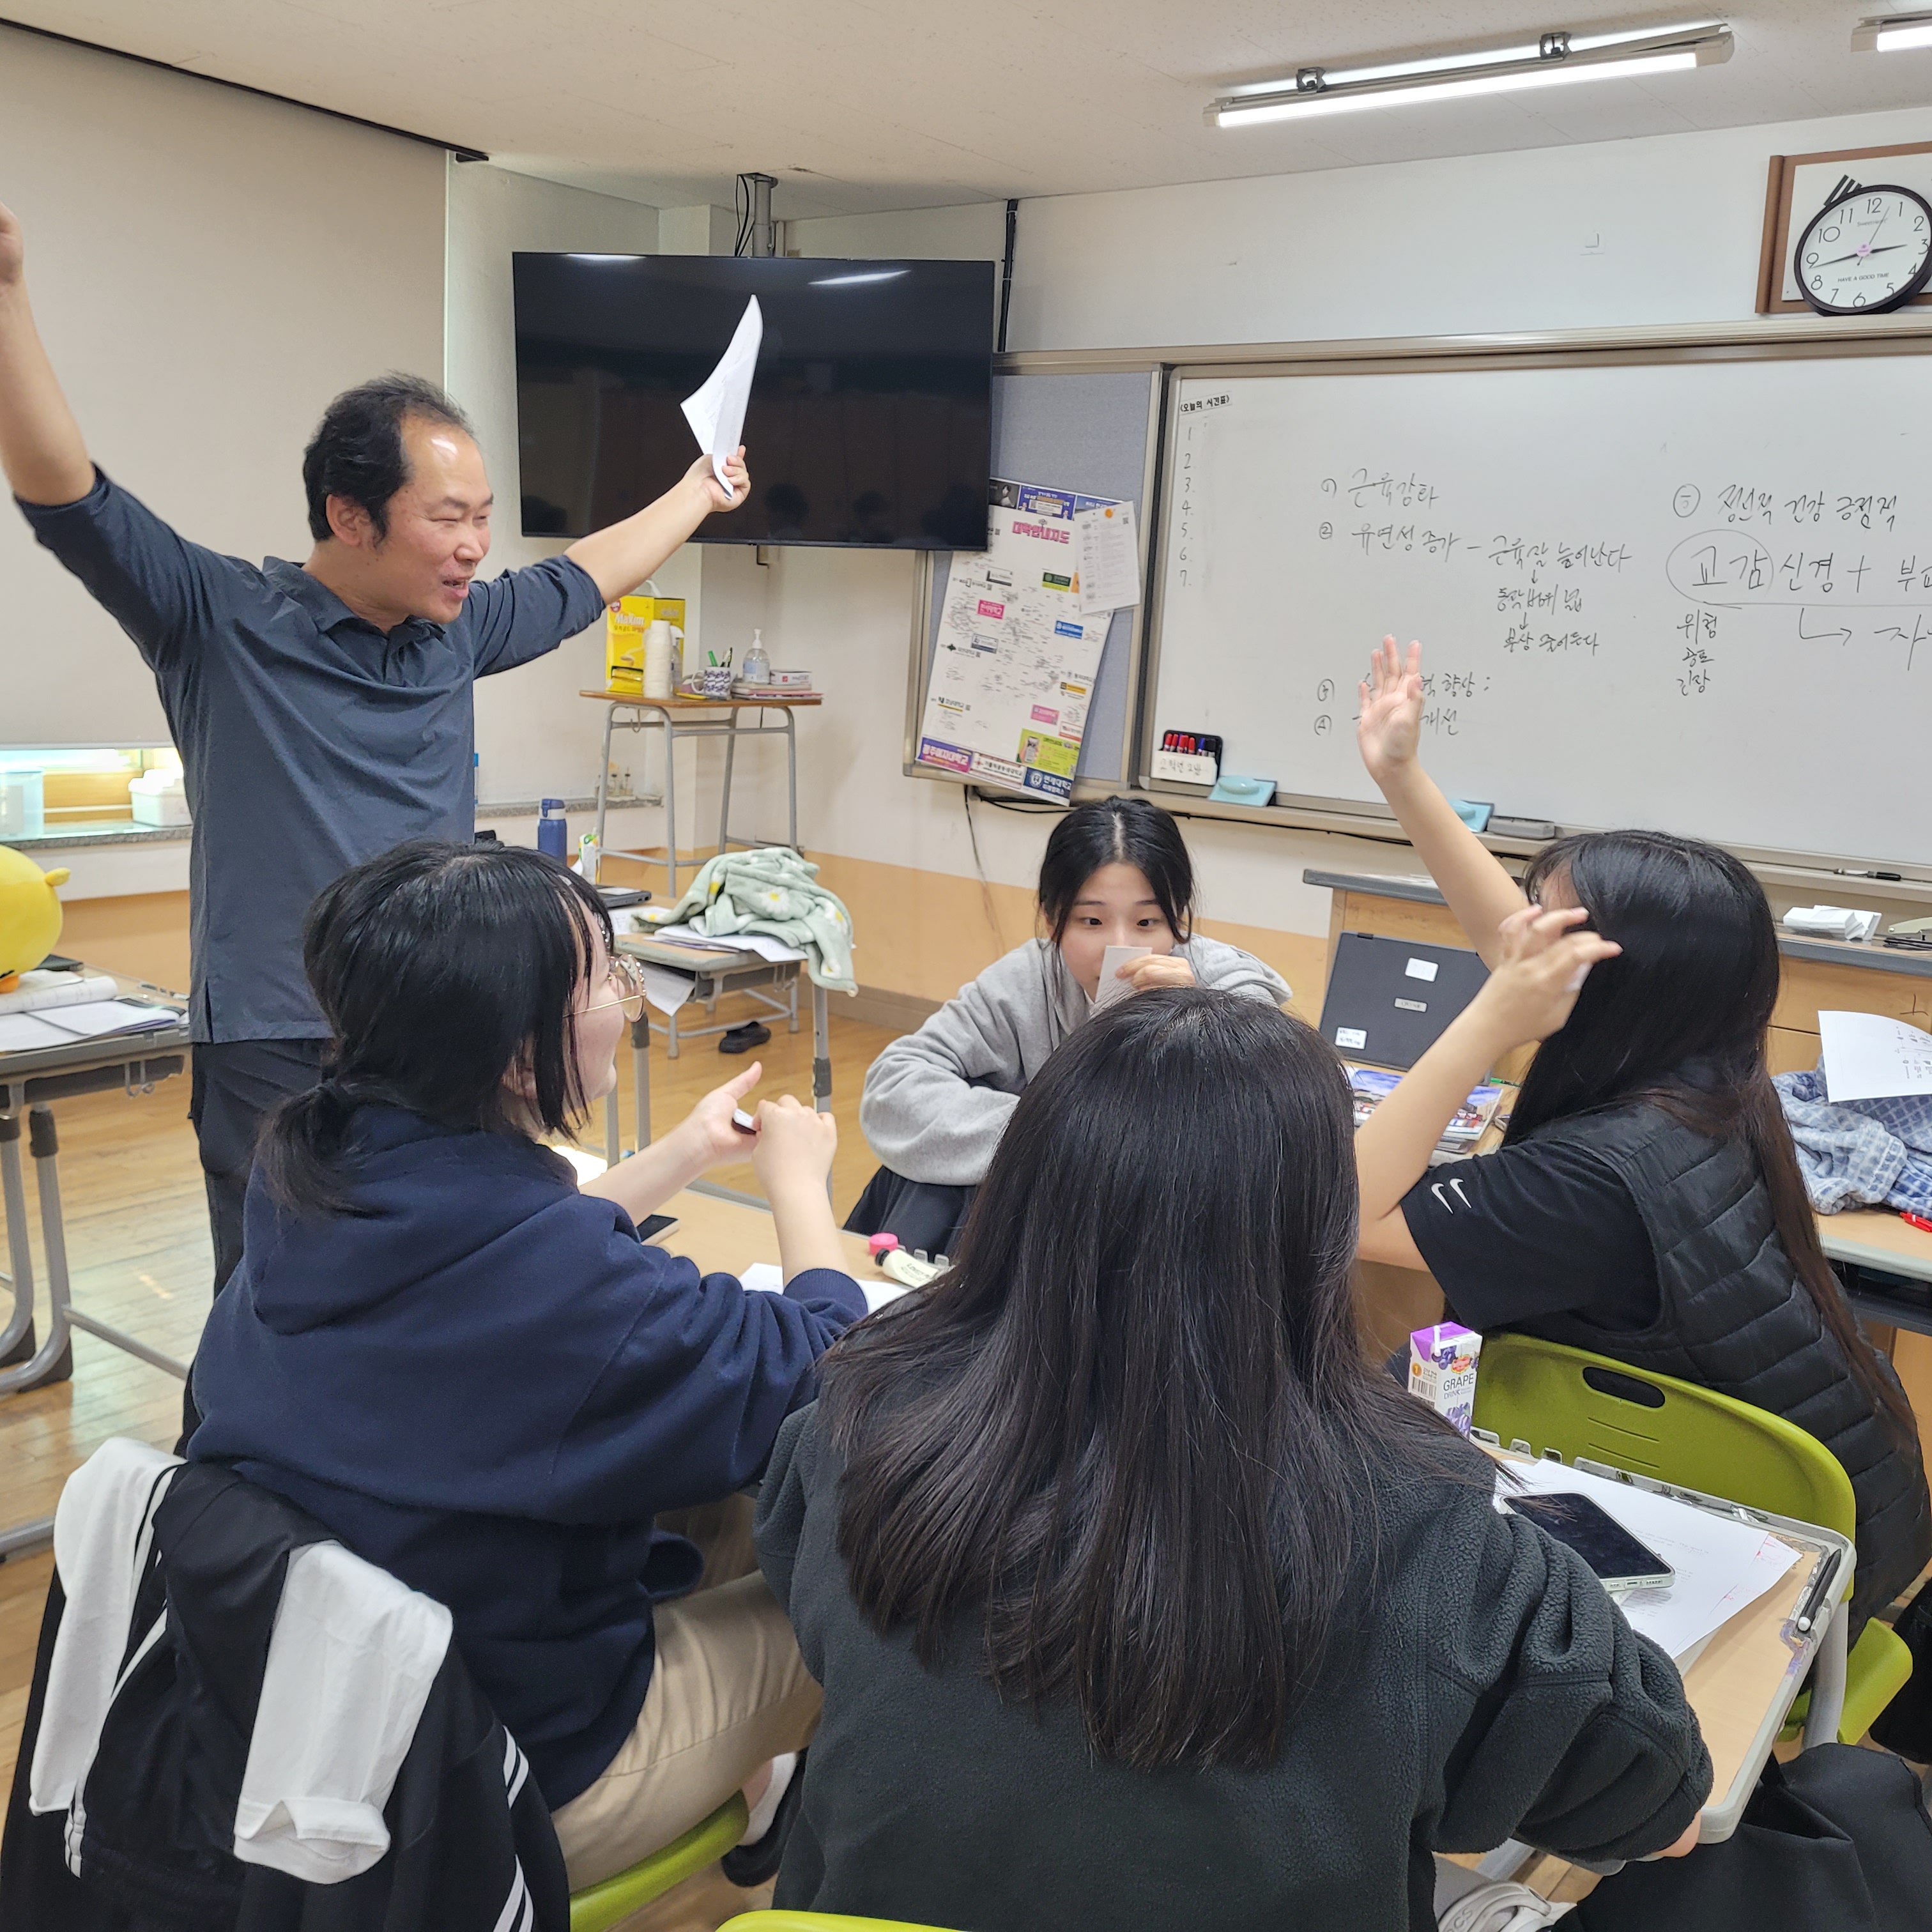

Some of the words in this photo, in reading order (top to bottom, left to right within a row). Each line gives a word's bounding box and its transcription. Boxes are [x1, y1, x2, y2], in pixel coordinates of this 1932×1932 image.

[1867, 197, 1882, 214] 12
[1899, 201, 1903, 217] 1
[1840, 208, 1853, 224] 11
[1913, 216, 1924, 232] 2
[1818, 226, 1841, 243] 10
[1918, 238, 1929, 255] 3
[1806, 252, 1820, 269] 9
[1908, 263, 1917, 275] 4
[1811, 275, 1823, 291] 8
[1887, 282, 1895, 296] 5
[1830, 289, 1839, 303] 7
[1853, 292, 1866, 308] 6
[1012, 521, 1071, 544] 대학안내지도
[1351, 523, 1415, 556] 유연성
[1422, 530, 1462, 562] 증가
[1557, 542, 1633, 573] 늘어난다
[615, 611, 645, 626] Maxim
[1443, 1373, 1474, 1392] GRAPE
